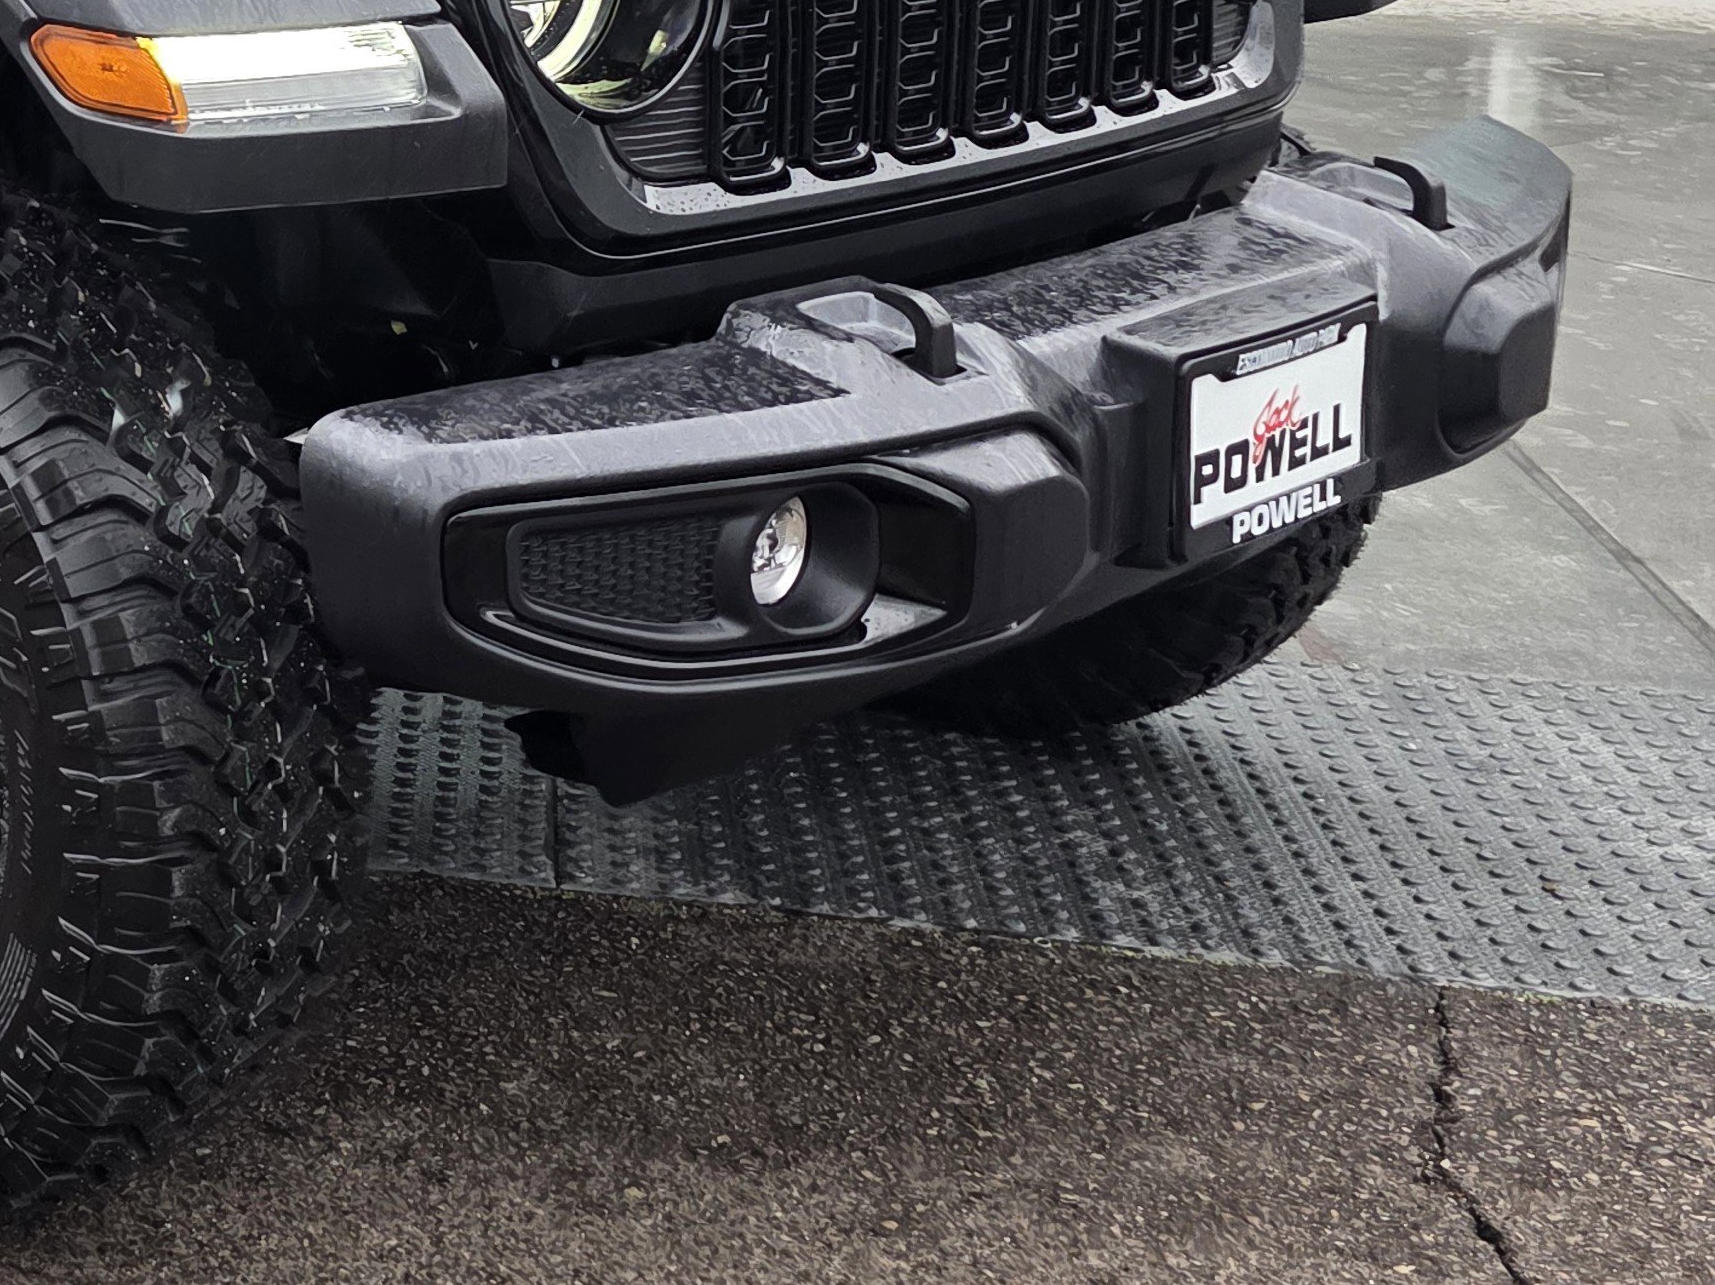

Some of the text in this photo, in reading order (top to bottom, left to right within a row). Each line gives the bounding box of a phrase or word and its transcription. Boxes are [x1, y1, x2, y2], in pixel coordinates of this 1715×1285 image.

[1192, 402, 1352, 506] POWELL
[1252, 383, 1303, 466] Jack
[1232, 477, 1341, 544] POWELL
